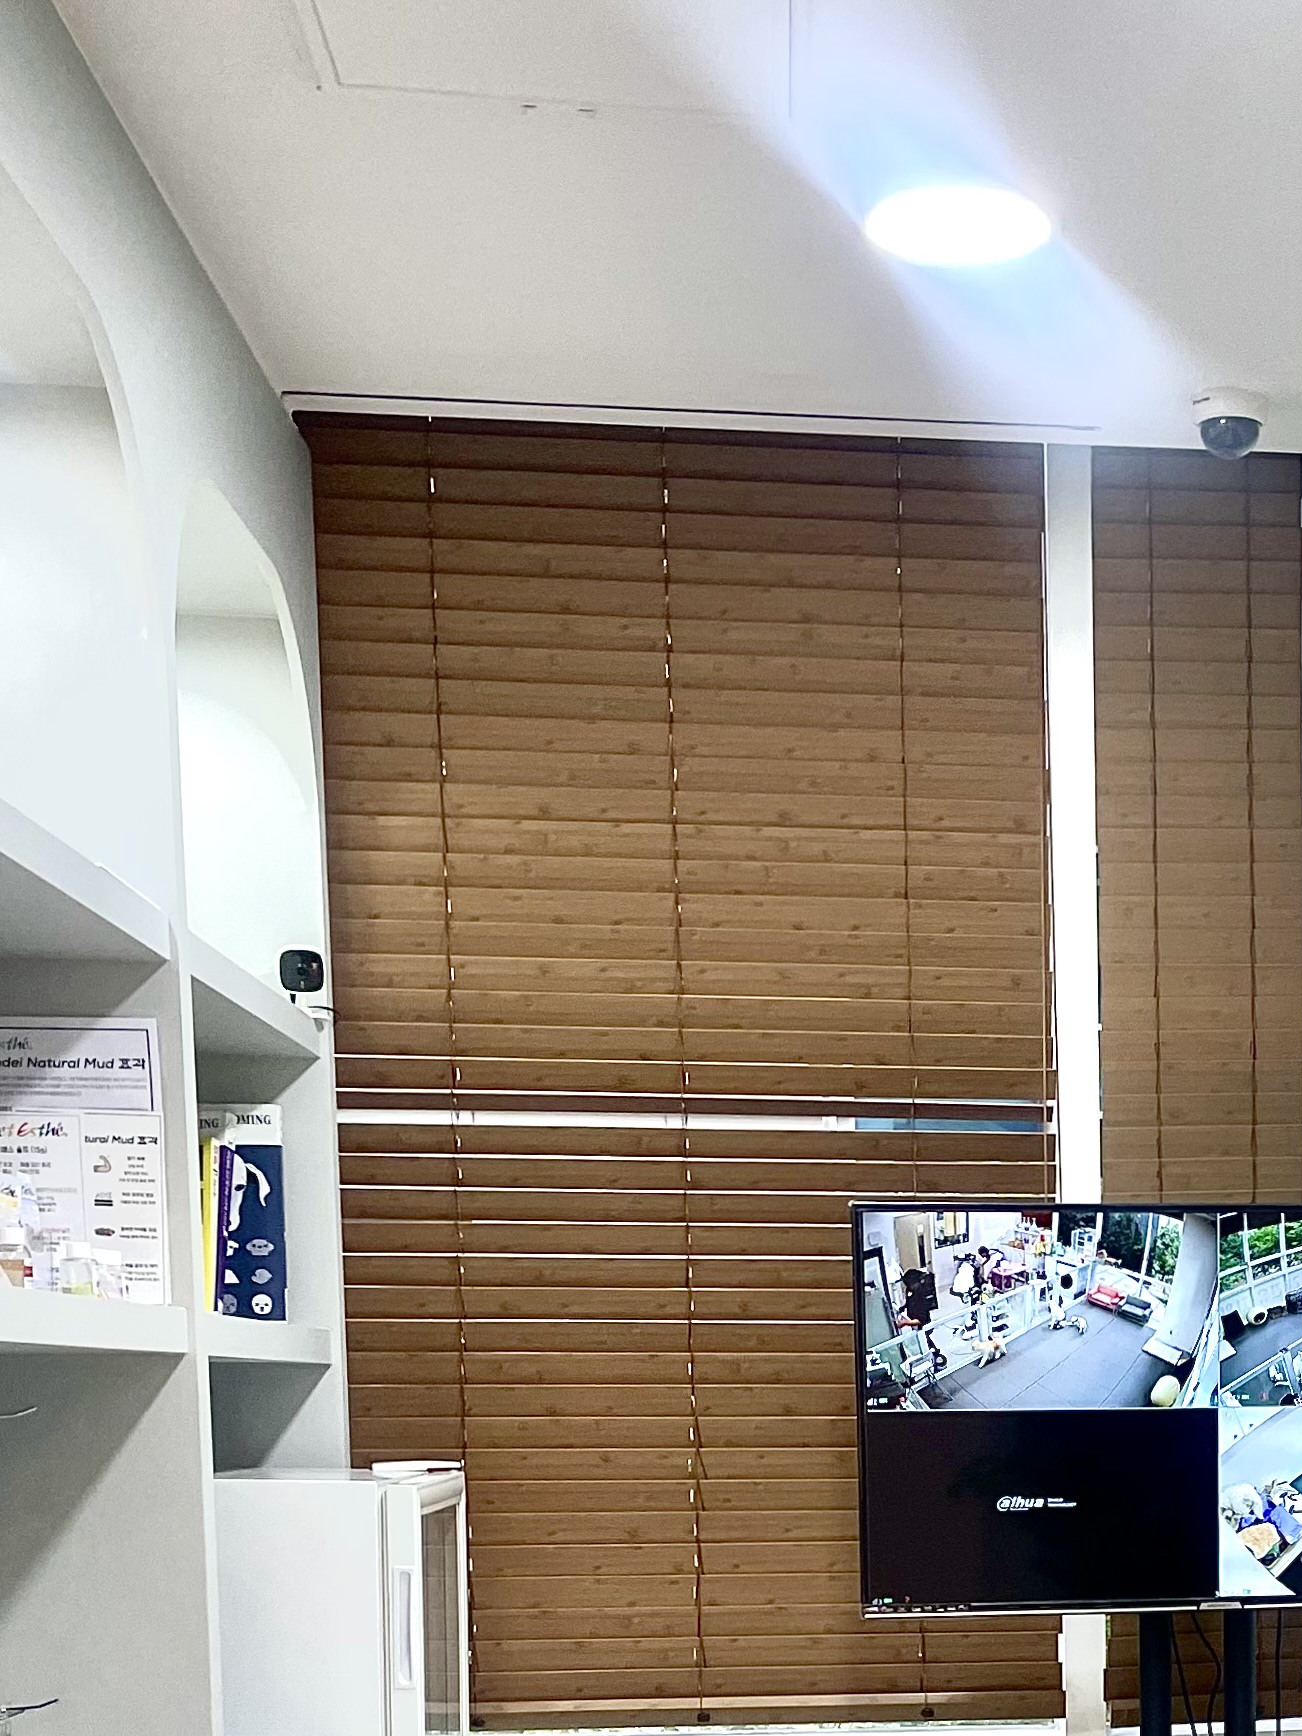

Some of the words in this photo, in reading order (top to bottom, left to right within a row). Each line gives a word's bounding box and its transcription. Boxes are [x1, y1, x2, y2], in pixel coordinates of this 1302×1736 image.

[27, 1056, 81, 1069] Natural
[84, 1057, 115, 1069] Mud
[112, 1135, 135, 1144] Mud
